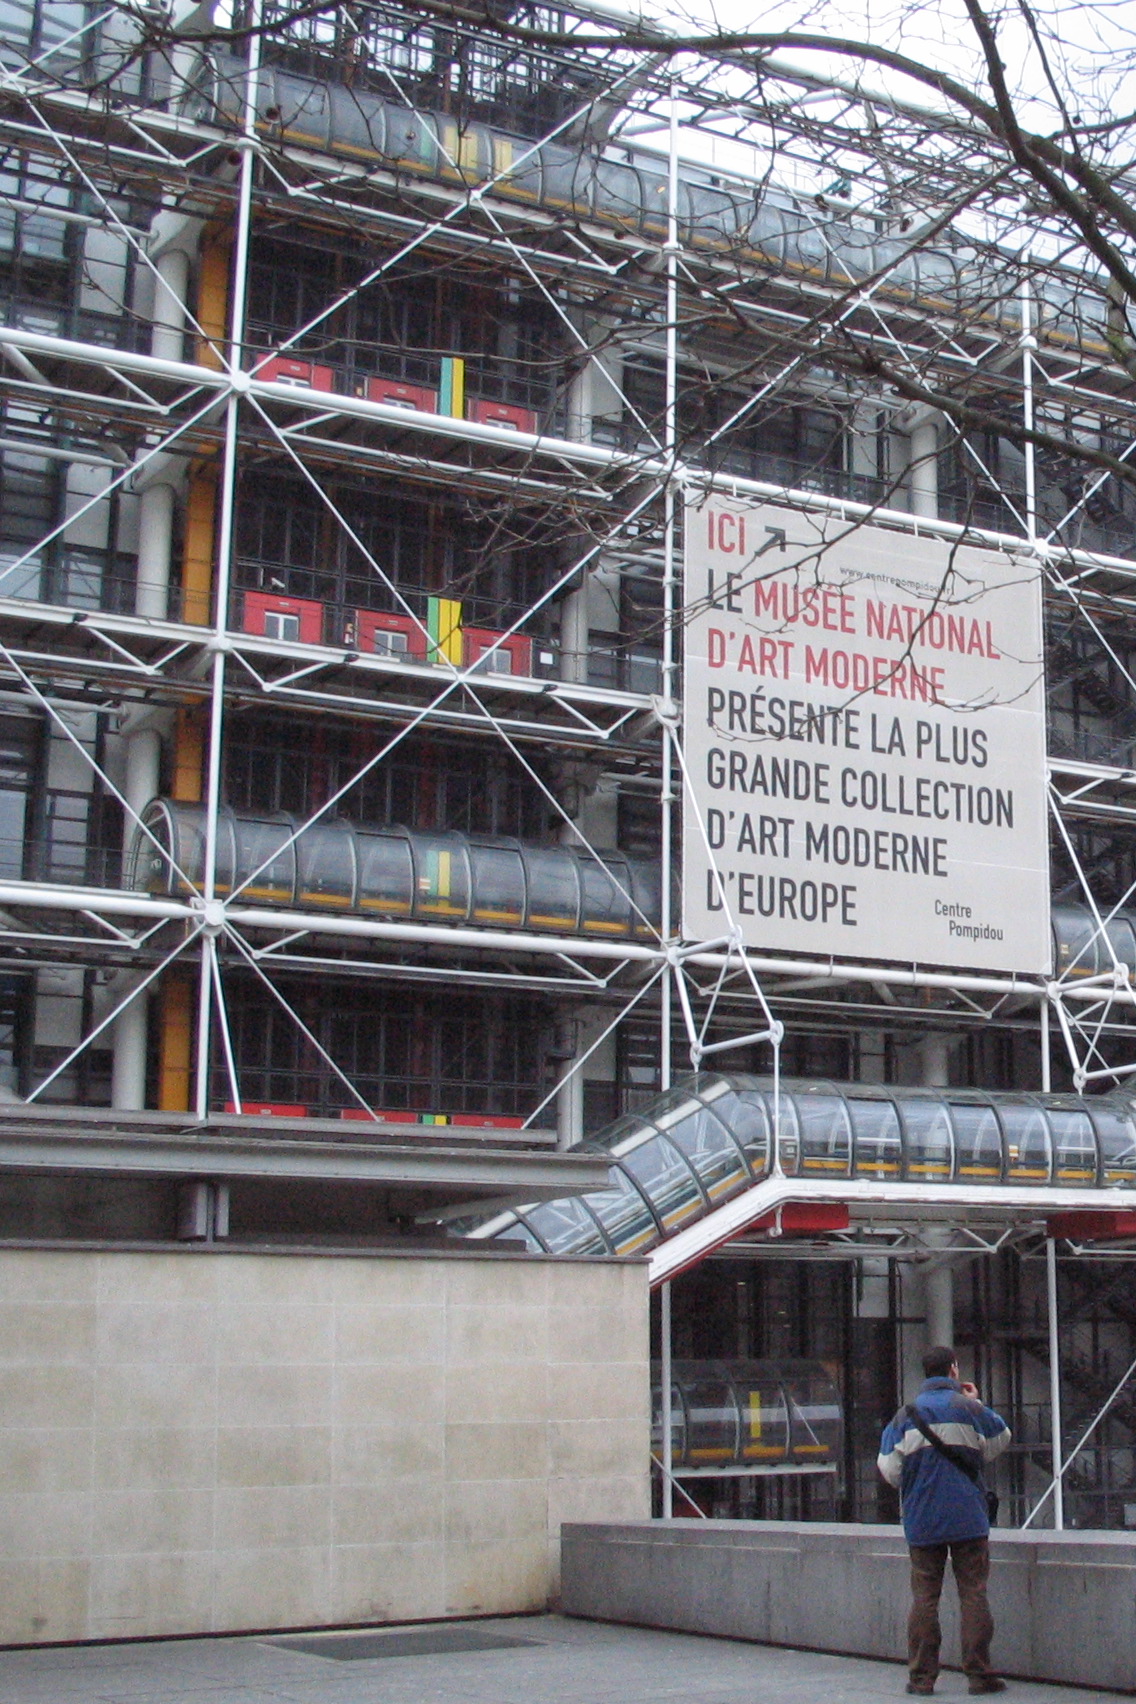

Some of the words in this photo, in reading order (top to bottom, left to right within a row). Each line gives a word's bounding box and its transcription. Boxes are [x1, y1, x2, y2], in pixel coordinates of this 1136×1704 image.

[708, 511, 745, 555] ICI
[839, 566, 952, 595] www.centrepompidour
[708, 568, 743, 613] LE
[755, 577, 856, 634] MUSÉE
[866, 598, 1001, 660] NATIONAL
[708, 628, 795, 680] D'ART
[805, 645, 945, 704] MODERNE
[708, 685, 860, 750] PRÉSENTE
[871, 713, 906, 757] LA
[916, 720, 988, 768] PLUS
[707, 747, 830, 804] GRANDE
[841, 767, 1014, 829] COLLECTION
[707, 808, 795, 858] D'ART
[806, 821, 948, 877] MODERNE
[707, 869, 857, 926] D'EUROPE
[935, 899, 972, 918] Centre
[949, 920, 1003, 942] Pompidou
